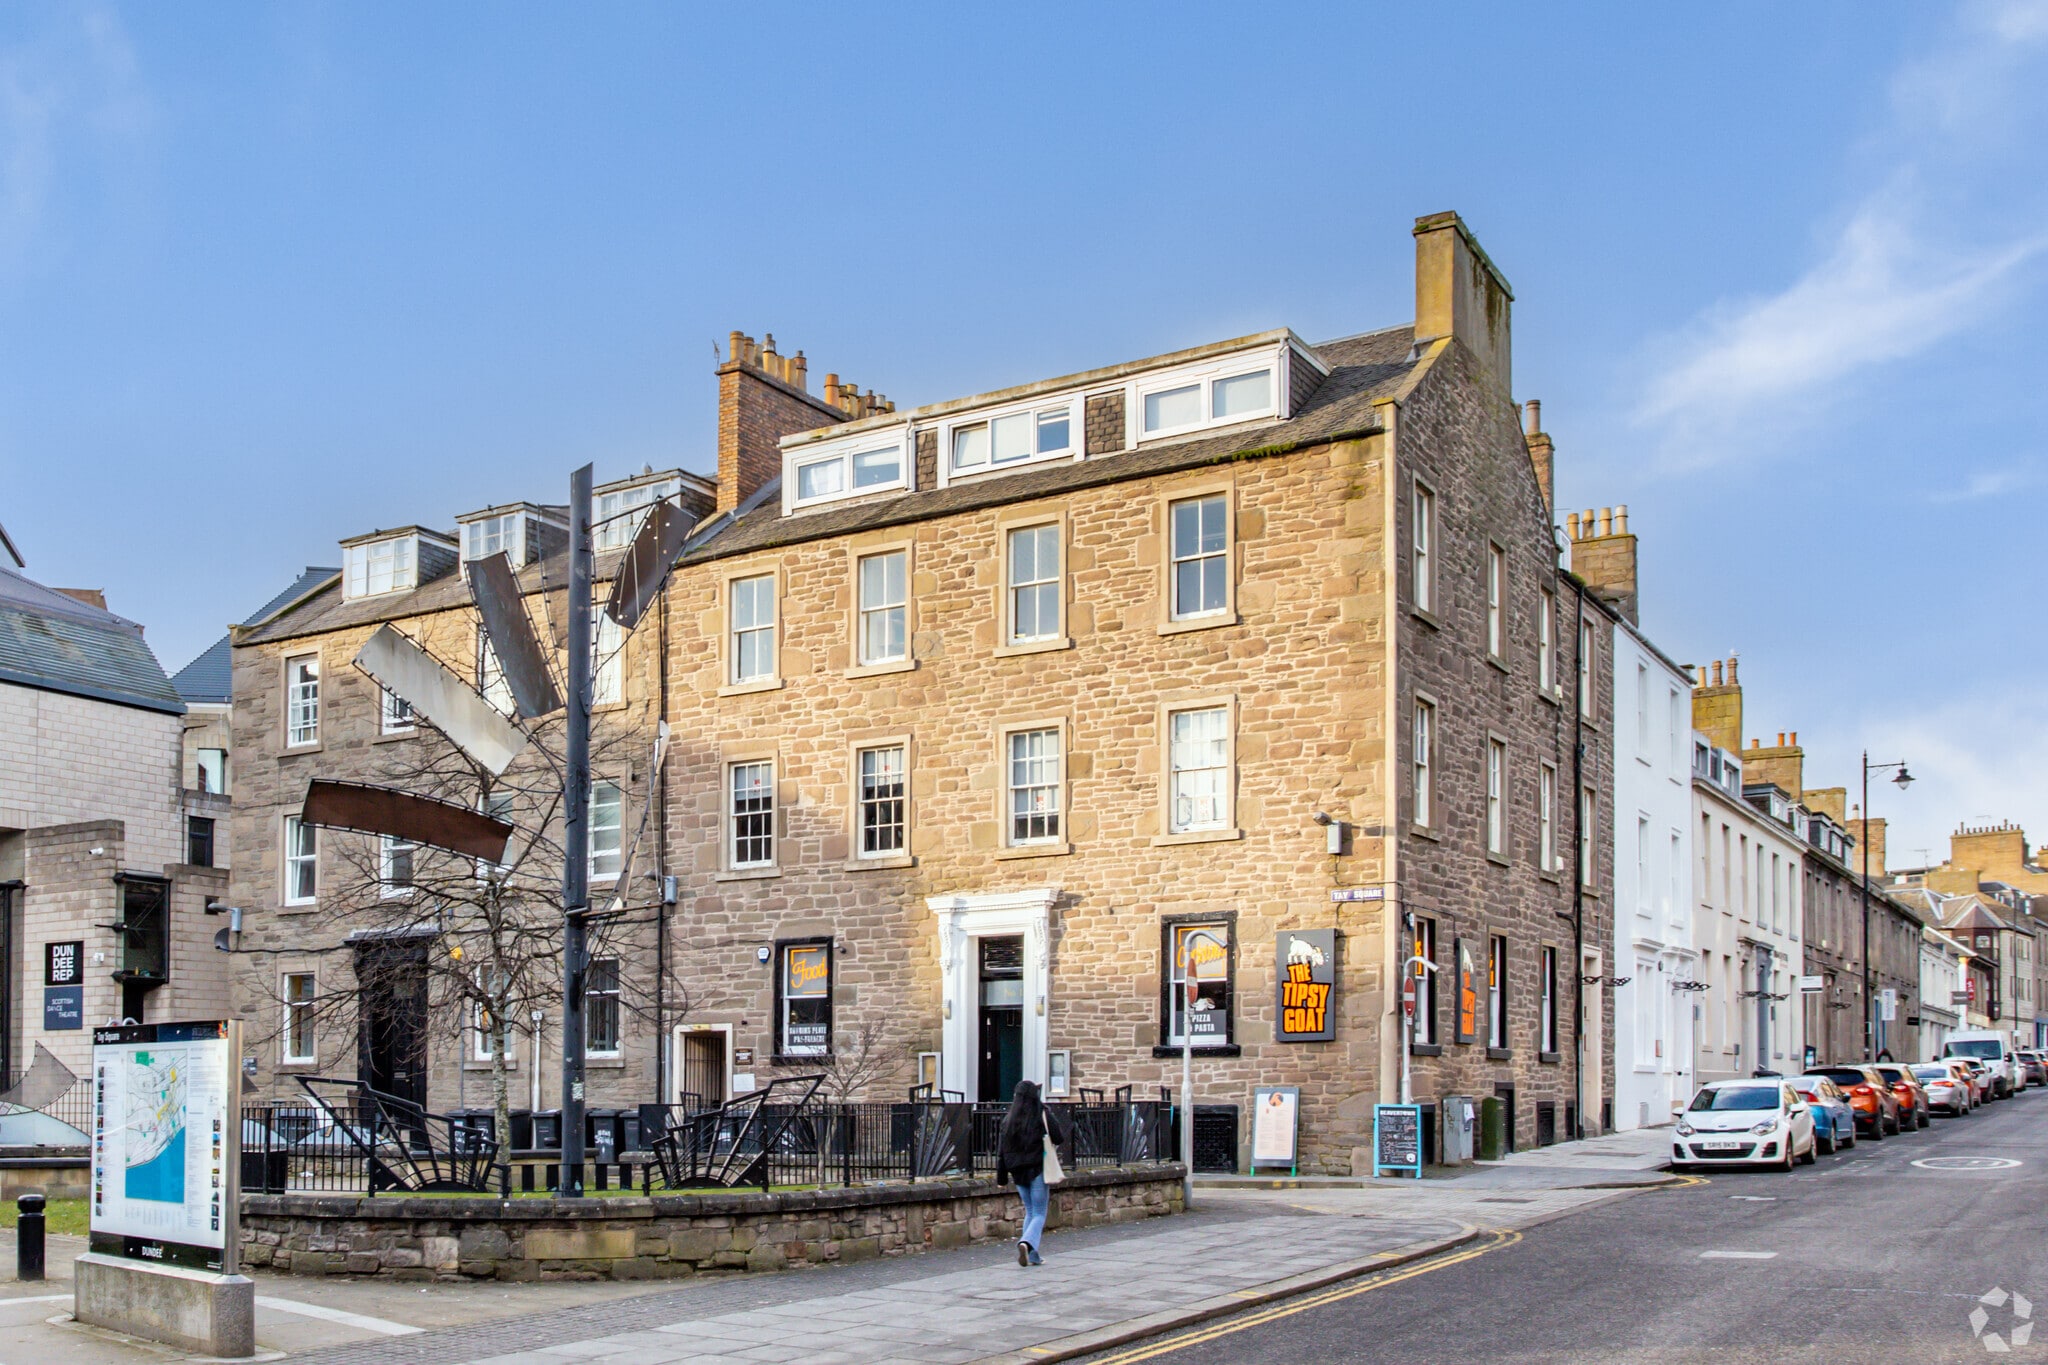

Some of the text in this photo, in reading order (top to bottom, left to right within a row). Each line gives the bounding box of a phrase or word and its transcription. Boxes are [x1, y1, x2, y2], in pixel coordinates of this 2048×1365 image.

[1333, 889, 1383, 900] TAY SQUARE
[52, 945, 74, 957] DUN
[52, 957, 74, 969] DEE
[52, 969, 74, 982] REP
[791, 956, 828, 988] Food
[1287, 964, 1312, 983] THE
[1282, 982, 1329, 1009] TIPSY
[1191, 1013, 1211, 1023] PIZZA
[1284, 1007, 1325, 1033] GOAT
[1194, 1023, 1215, 1033] PASTA
[141, 1246, 163, 1258] DUNDEE
